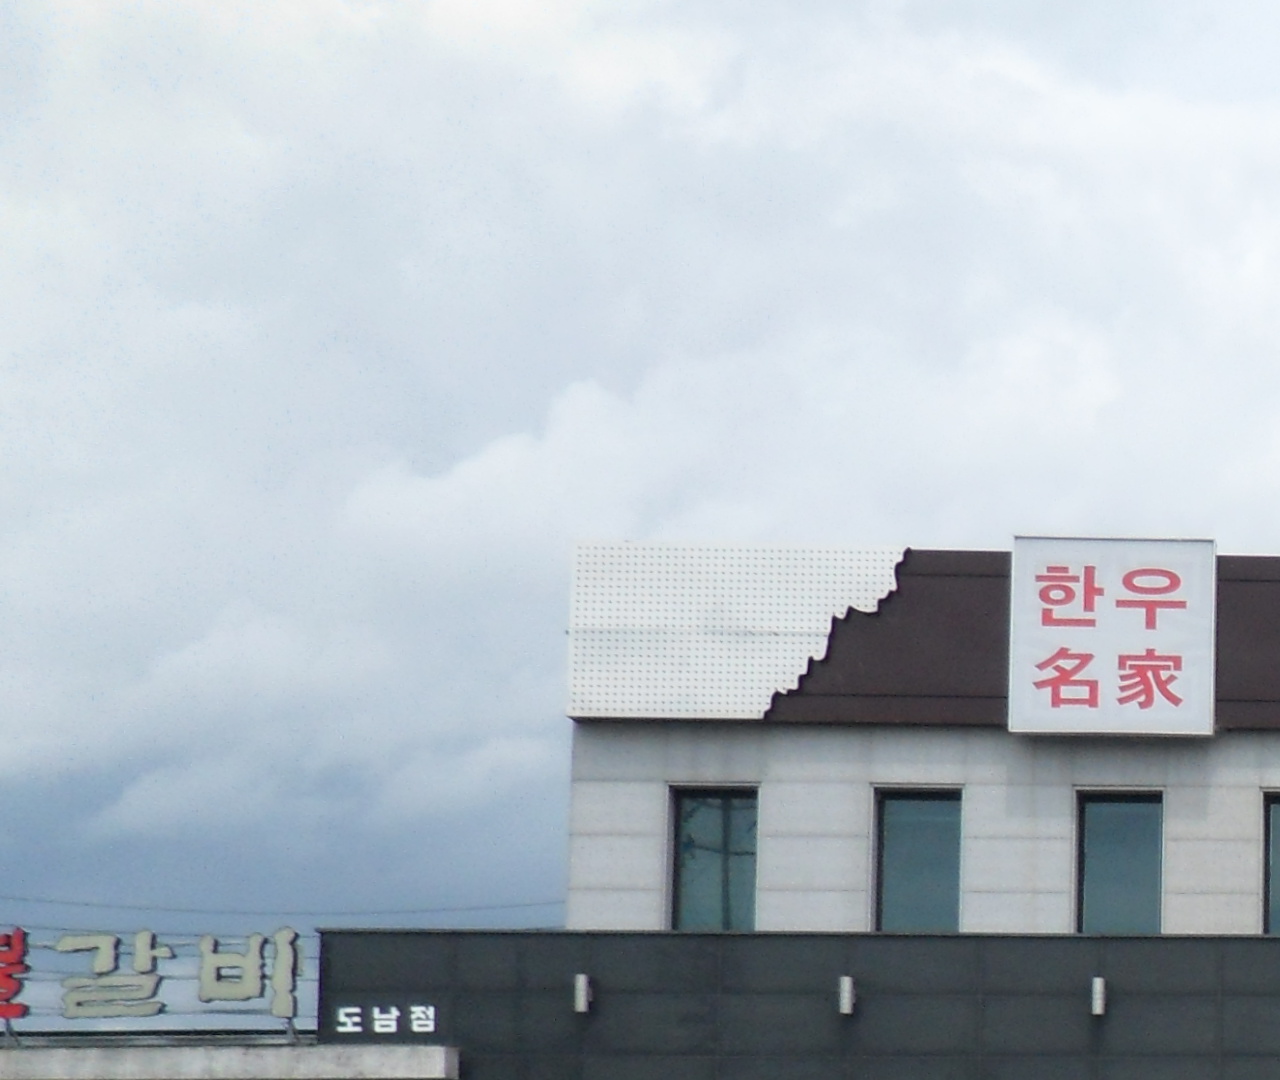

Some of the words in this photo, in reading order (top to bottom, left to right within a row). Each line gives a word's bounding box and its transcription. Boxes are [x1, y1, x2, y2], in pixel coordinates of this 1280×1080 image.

[1035, 565, 1188, 631] 한우
[1034, 646, 1183, 709] 名家
[335, 1005, 436, 1034] 도남점
